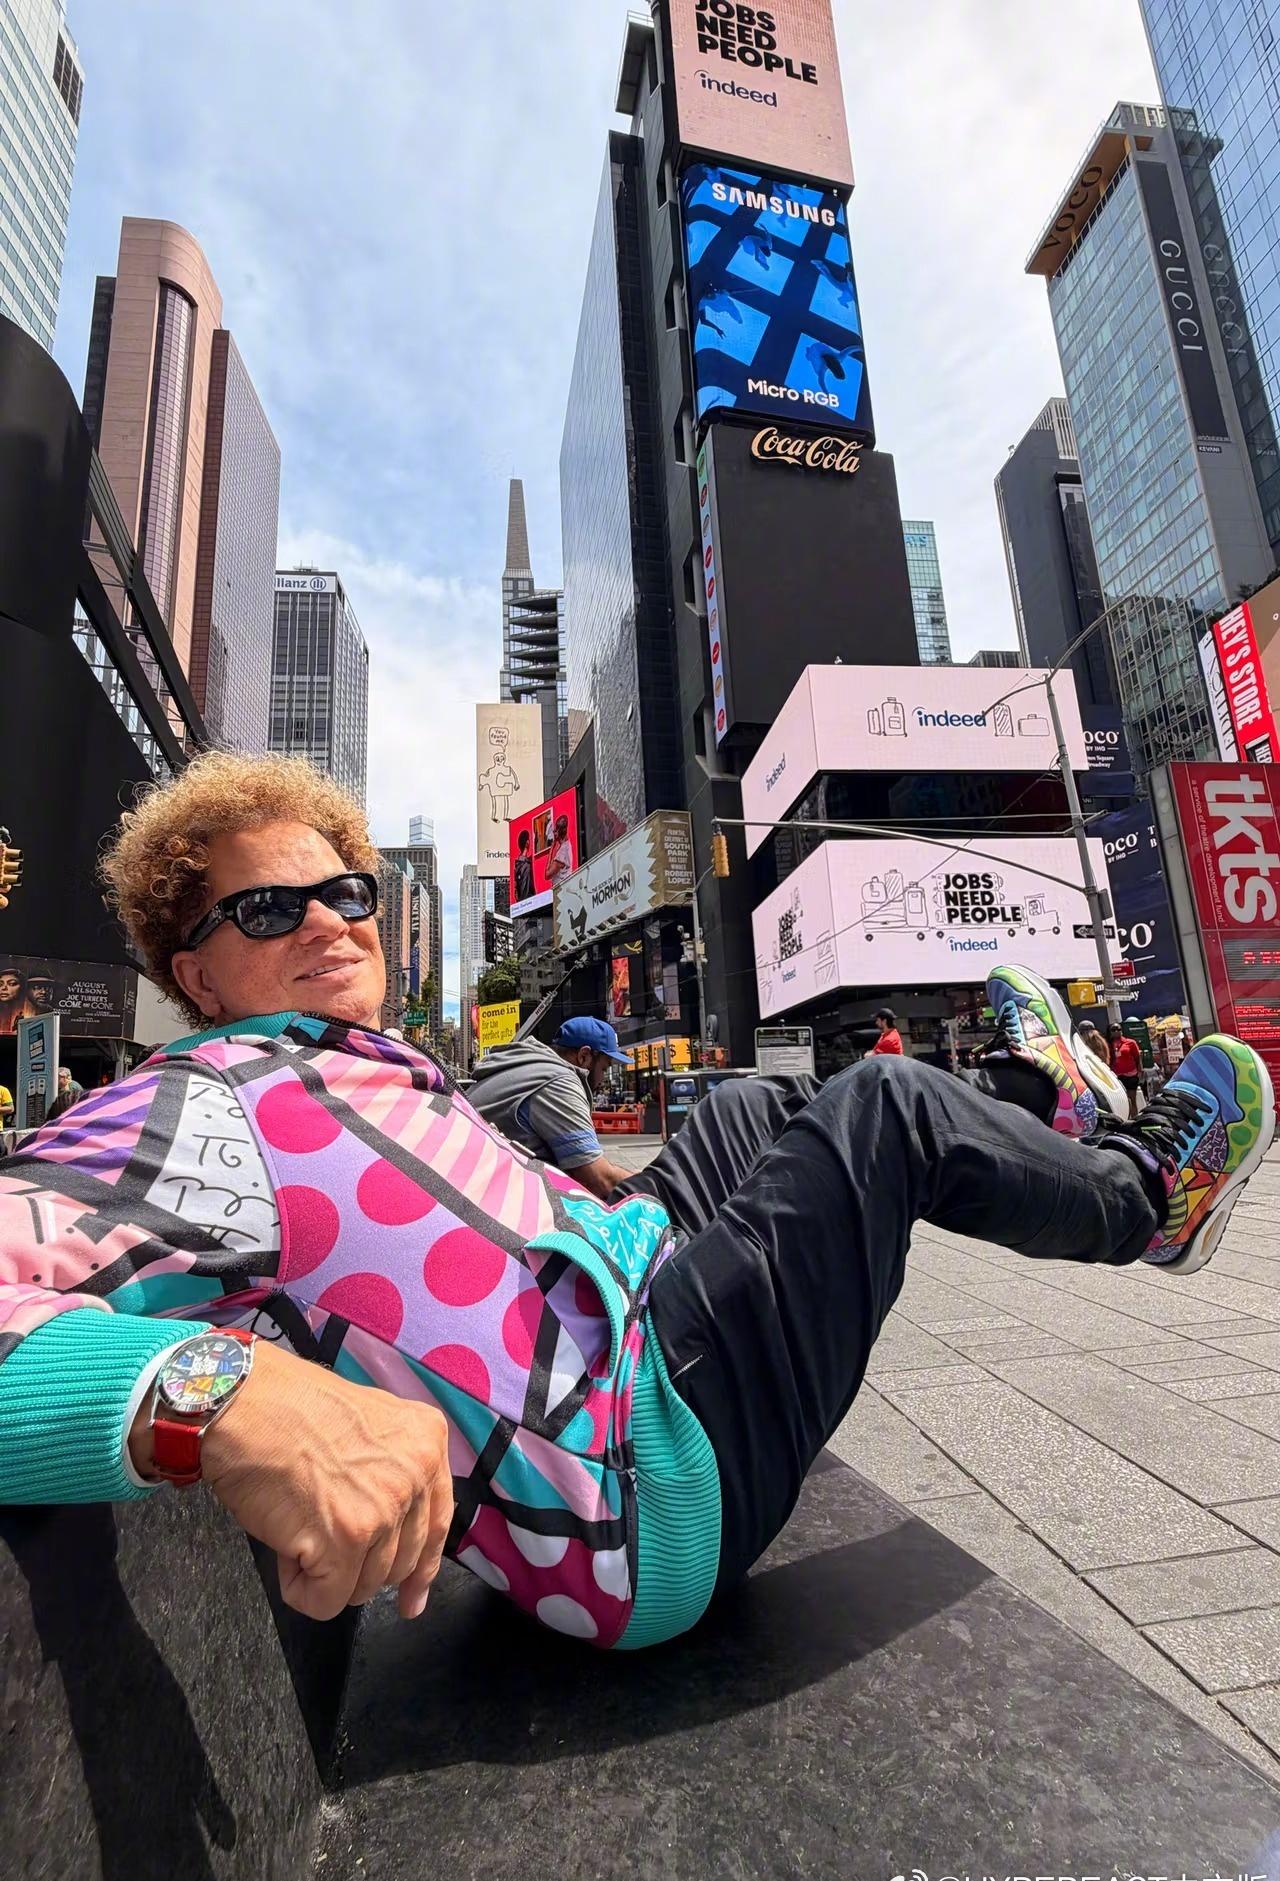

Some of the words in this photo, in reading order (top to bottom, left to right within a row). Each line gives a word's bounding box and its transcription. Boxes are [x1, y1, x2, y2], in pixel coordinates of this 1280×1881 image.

[695, 0, 776, 32] JOBS
[696, 13, 777, 50] NEED
[698, 33, 818, 85] PEOPLE
[695, 70, 777, 107] indeed
[712, 182, 835, 226] SAMSUNG
[1158, 239, 1203, 351] GUCCI
[747, 378, 799, 401] Micro
[803, 389, 840, 407] RGB
[751, 426, 863, 474] Coca-Cola
[1229, 662, 1263, 731] STORE
[914, 708, 986, 727] indeed
[1083, 731, 1118, 744] oco
[485, 850, 510, 858] indee
[664, 842, 690, 850] SOUTH
[1104, 834, 1137, 856] oco
[1192, 786, 1202, 813] service
[1198, 815, 1206, 823] of
[1206, 853, 1221, 902] development
[1215, 903, 1225, 922] fund
[1204, 774, 1280, 923] tkts
[592, 871, 631, 909] MORMON
[667, 877, 691, 885] LOPEZ
[943, 873, 994, 890] JOBS
[945, 890, 995, 907] NEED
[945, 906, 1022, 924] PEOPLE
[947, 937, 998, 952] indeed
[67, 986, 109, 995] WILSON'S
[72, 981, 106, 989] AUGUST
[58, 1000, 82, 1008] COME
[91, 1002, 114, 1010] GONE
[482, 1007, 505, 1018] come
[506, 1004, 516, 1014] in
